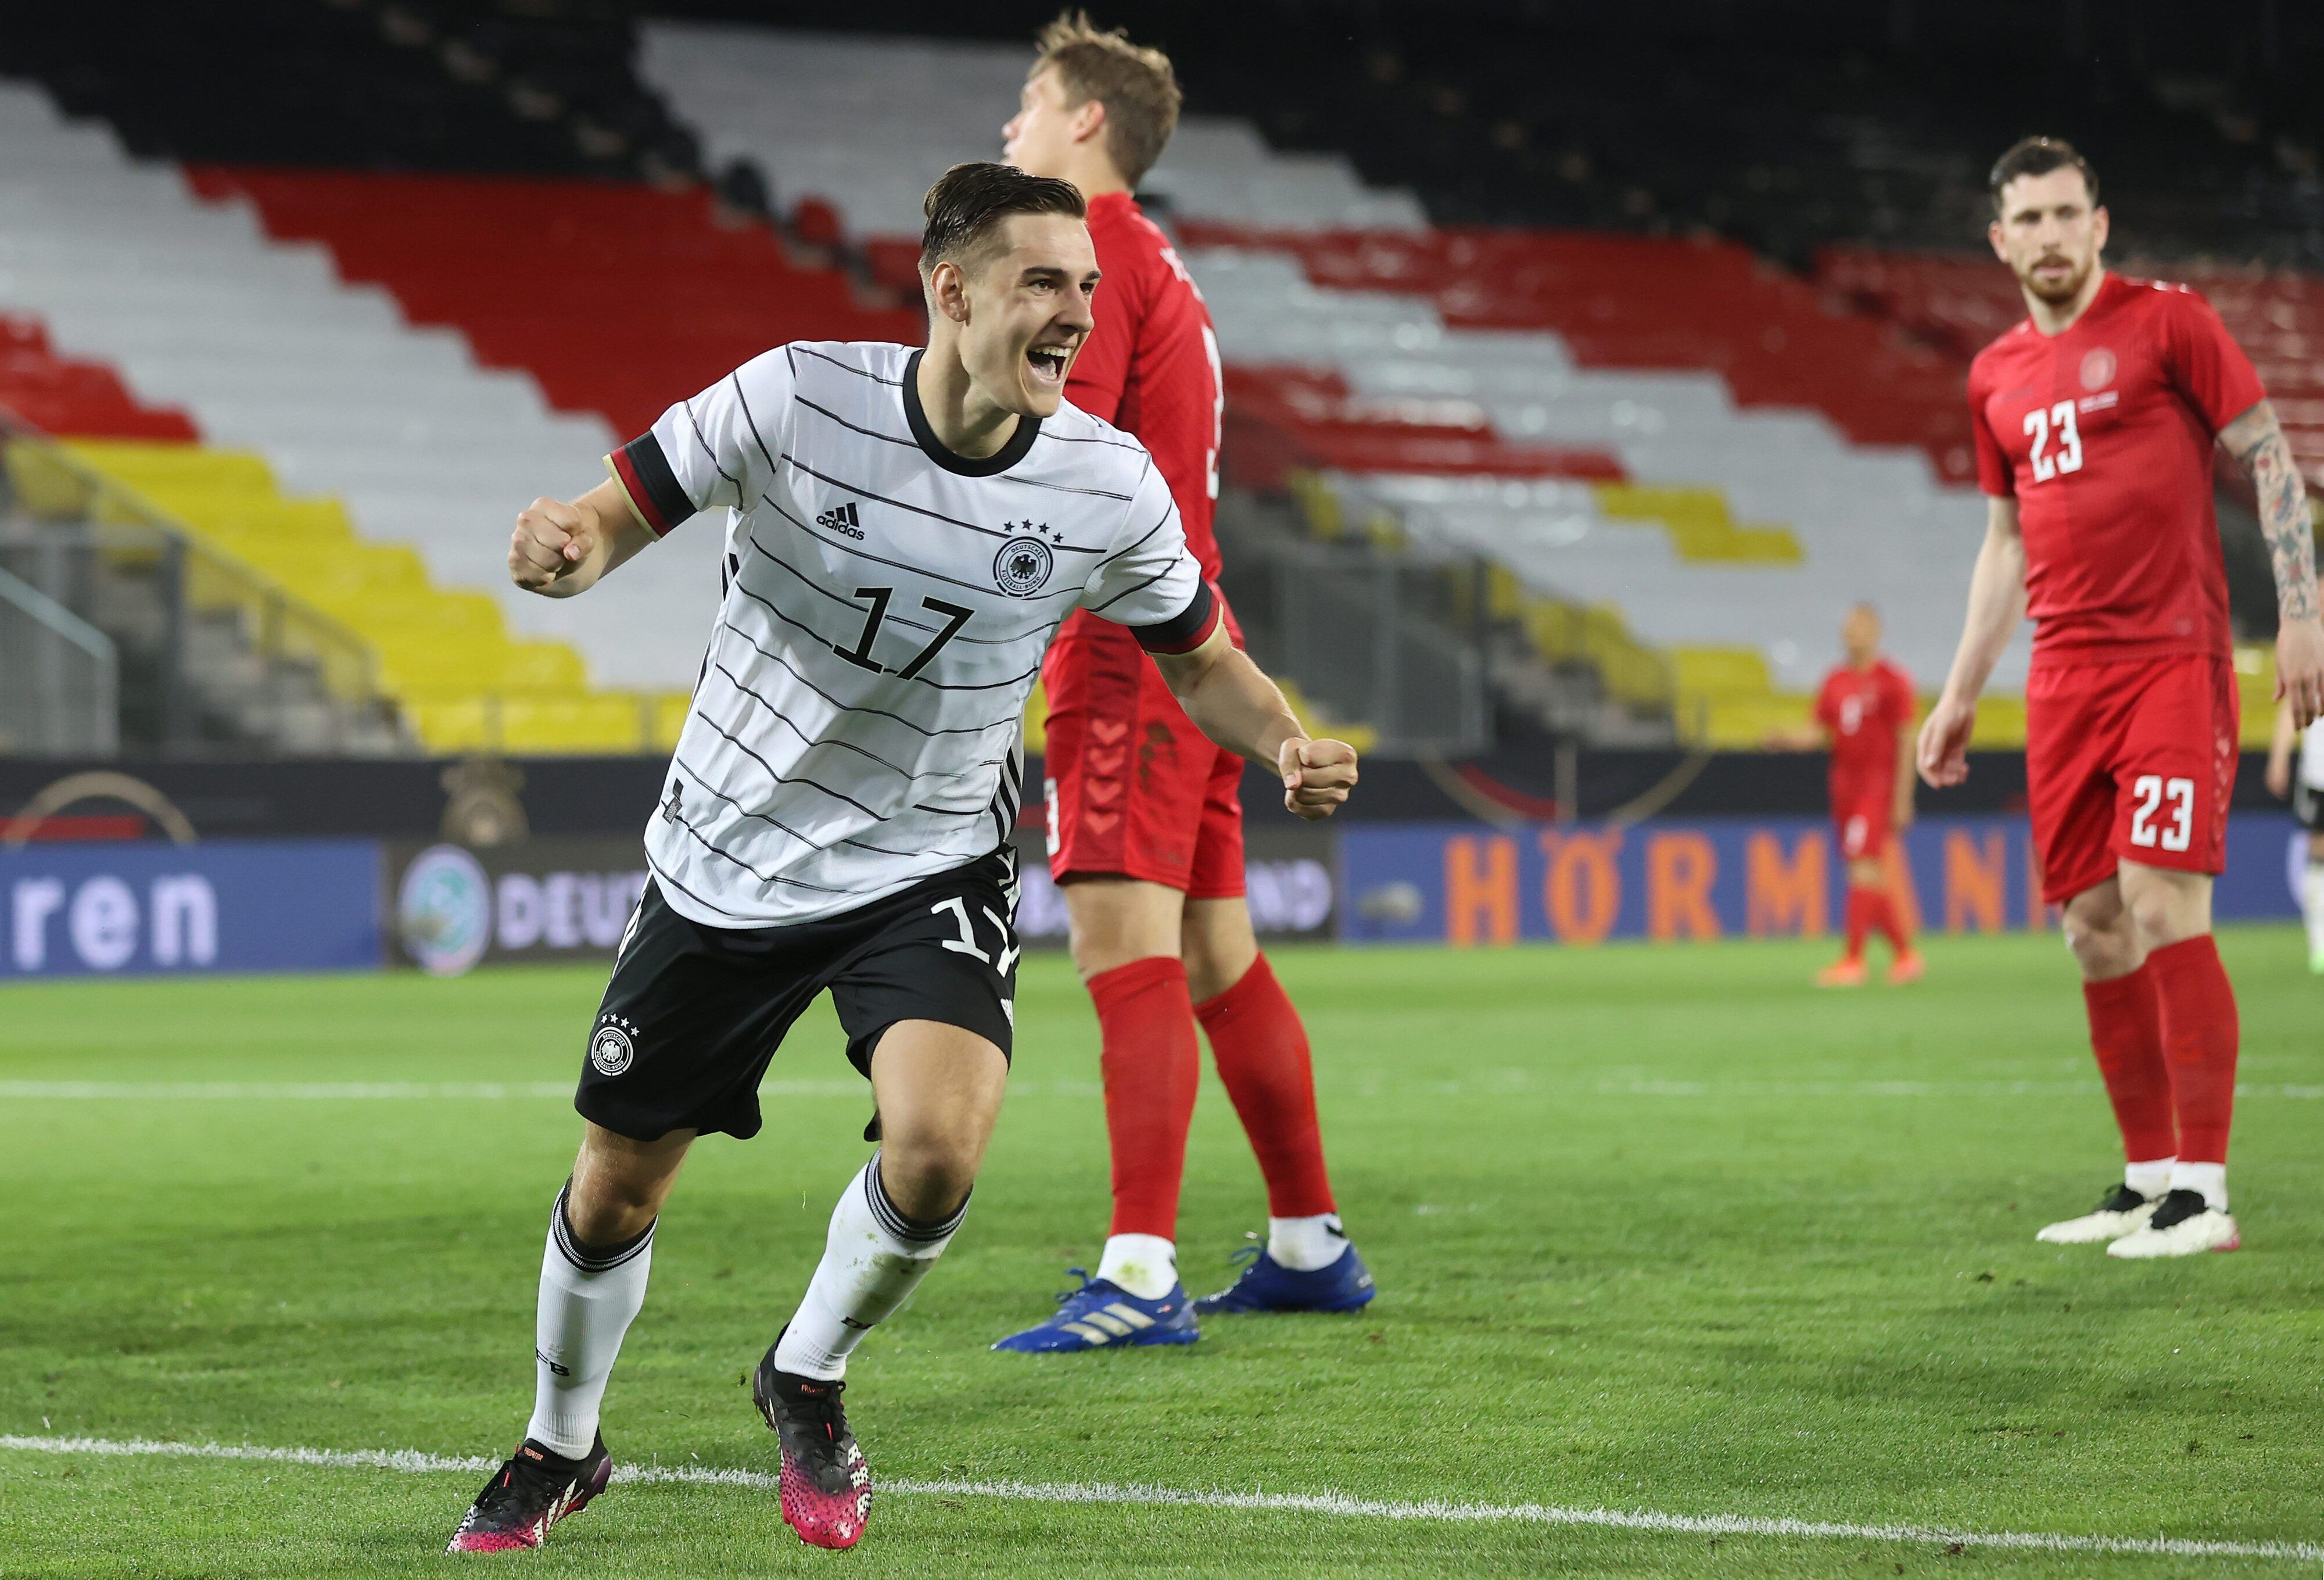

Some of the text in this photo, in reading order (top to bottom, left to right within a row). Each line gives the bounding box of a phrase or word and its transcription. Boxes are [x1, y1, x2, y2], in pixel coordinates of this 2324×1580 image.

[2023, 399, 2083, 483] 23
[816, 515, 865, 540] adidas
[1011, 544, 1044, 558] DEUTSCHER
[833, 587, 975, 680] 17
[2131, 775, 2194, 852] 23
